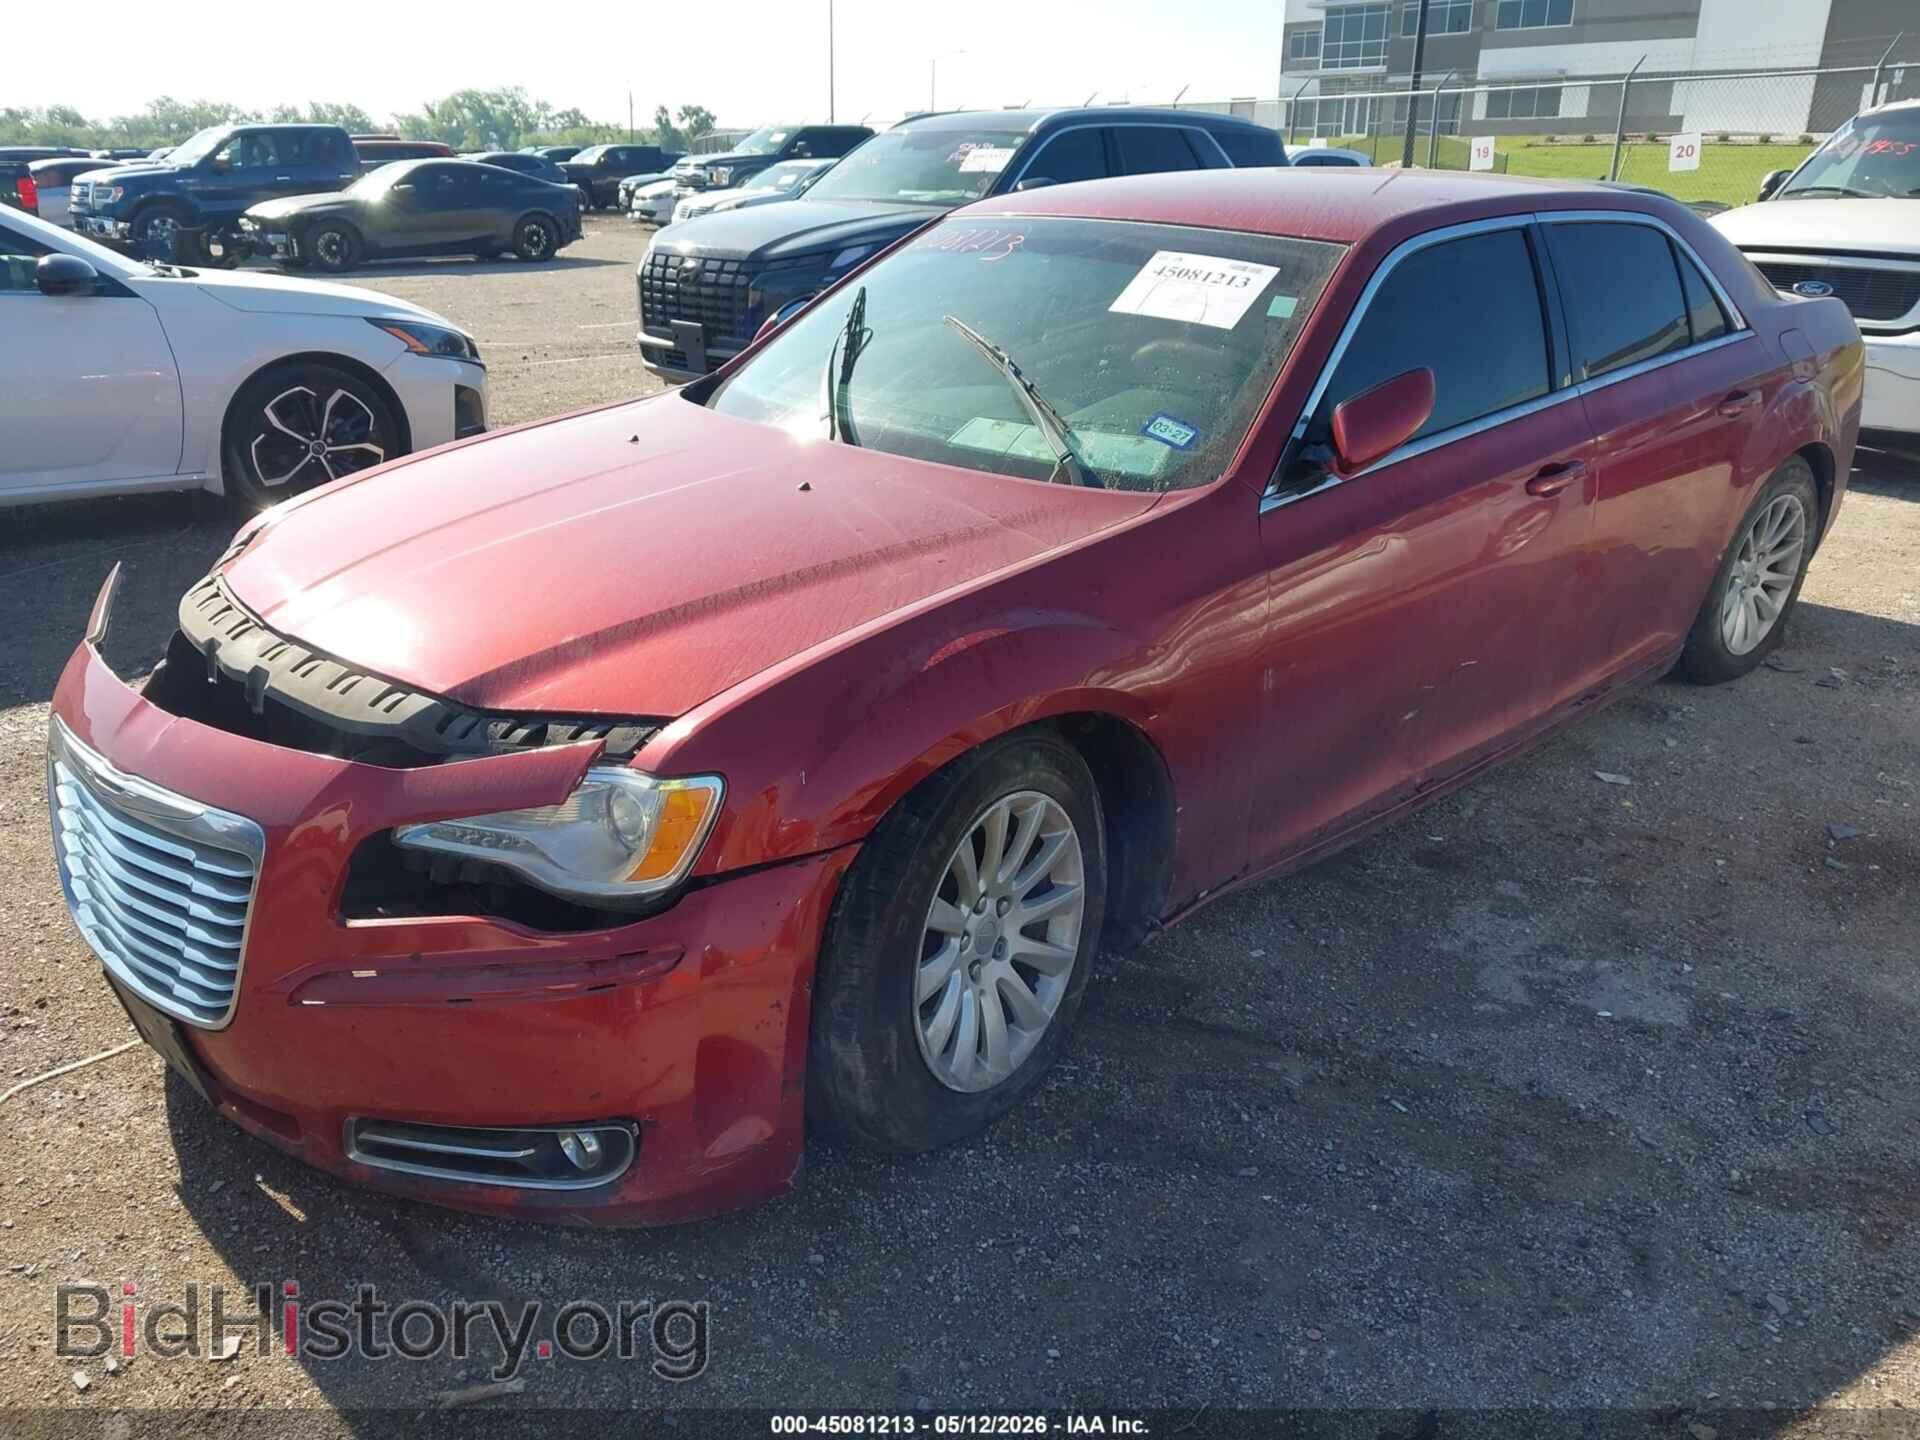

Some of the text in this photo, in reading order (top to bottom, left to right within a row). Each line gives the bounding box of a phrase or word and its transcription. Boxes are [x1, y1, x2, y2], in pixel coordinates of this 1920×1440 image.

[1475, 147, 1489, 158] 19
[1675, 144, 1694, 158] 20
[1153, 264, 1251, 289] 45081213
